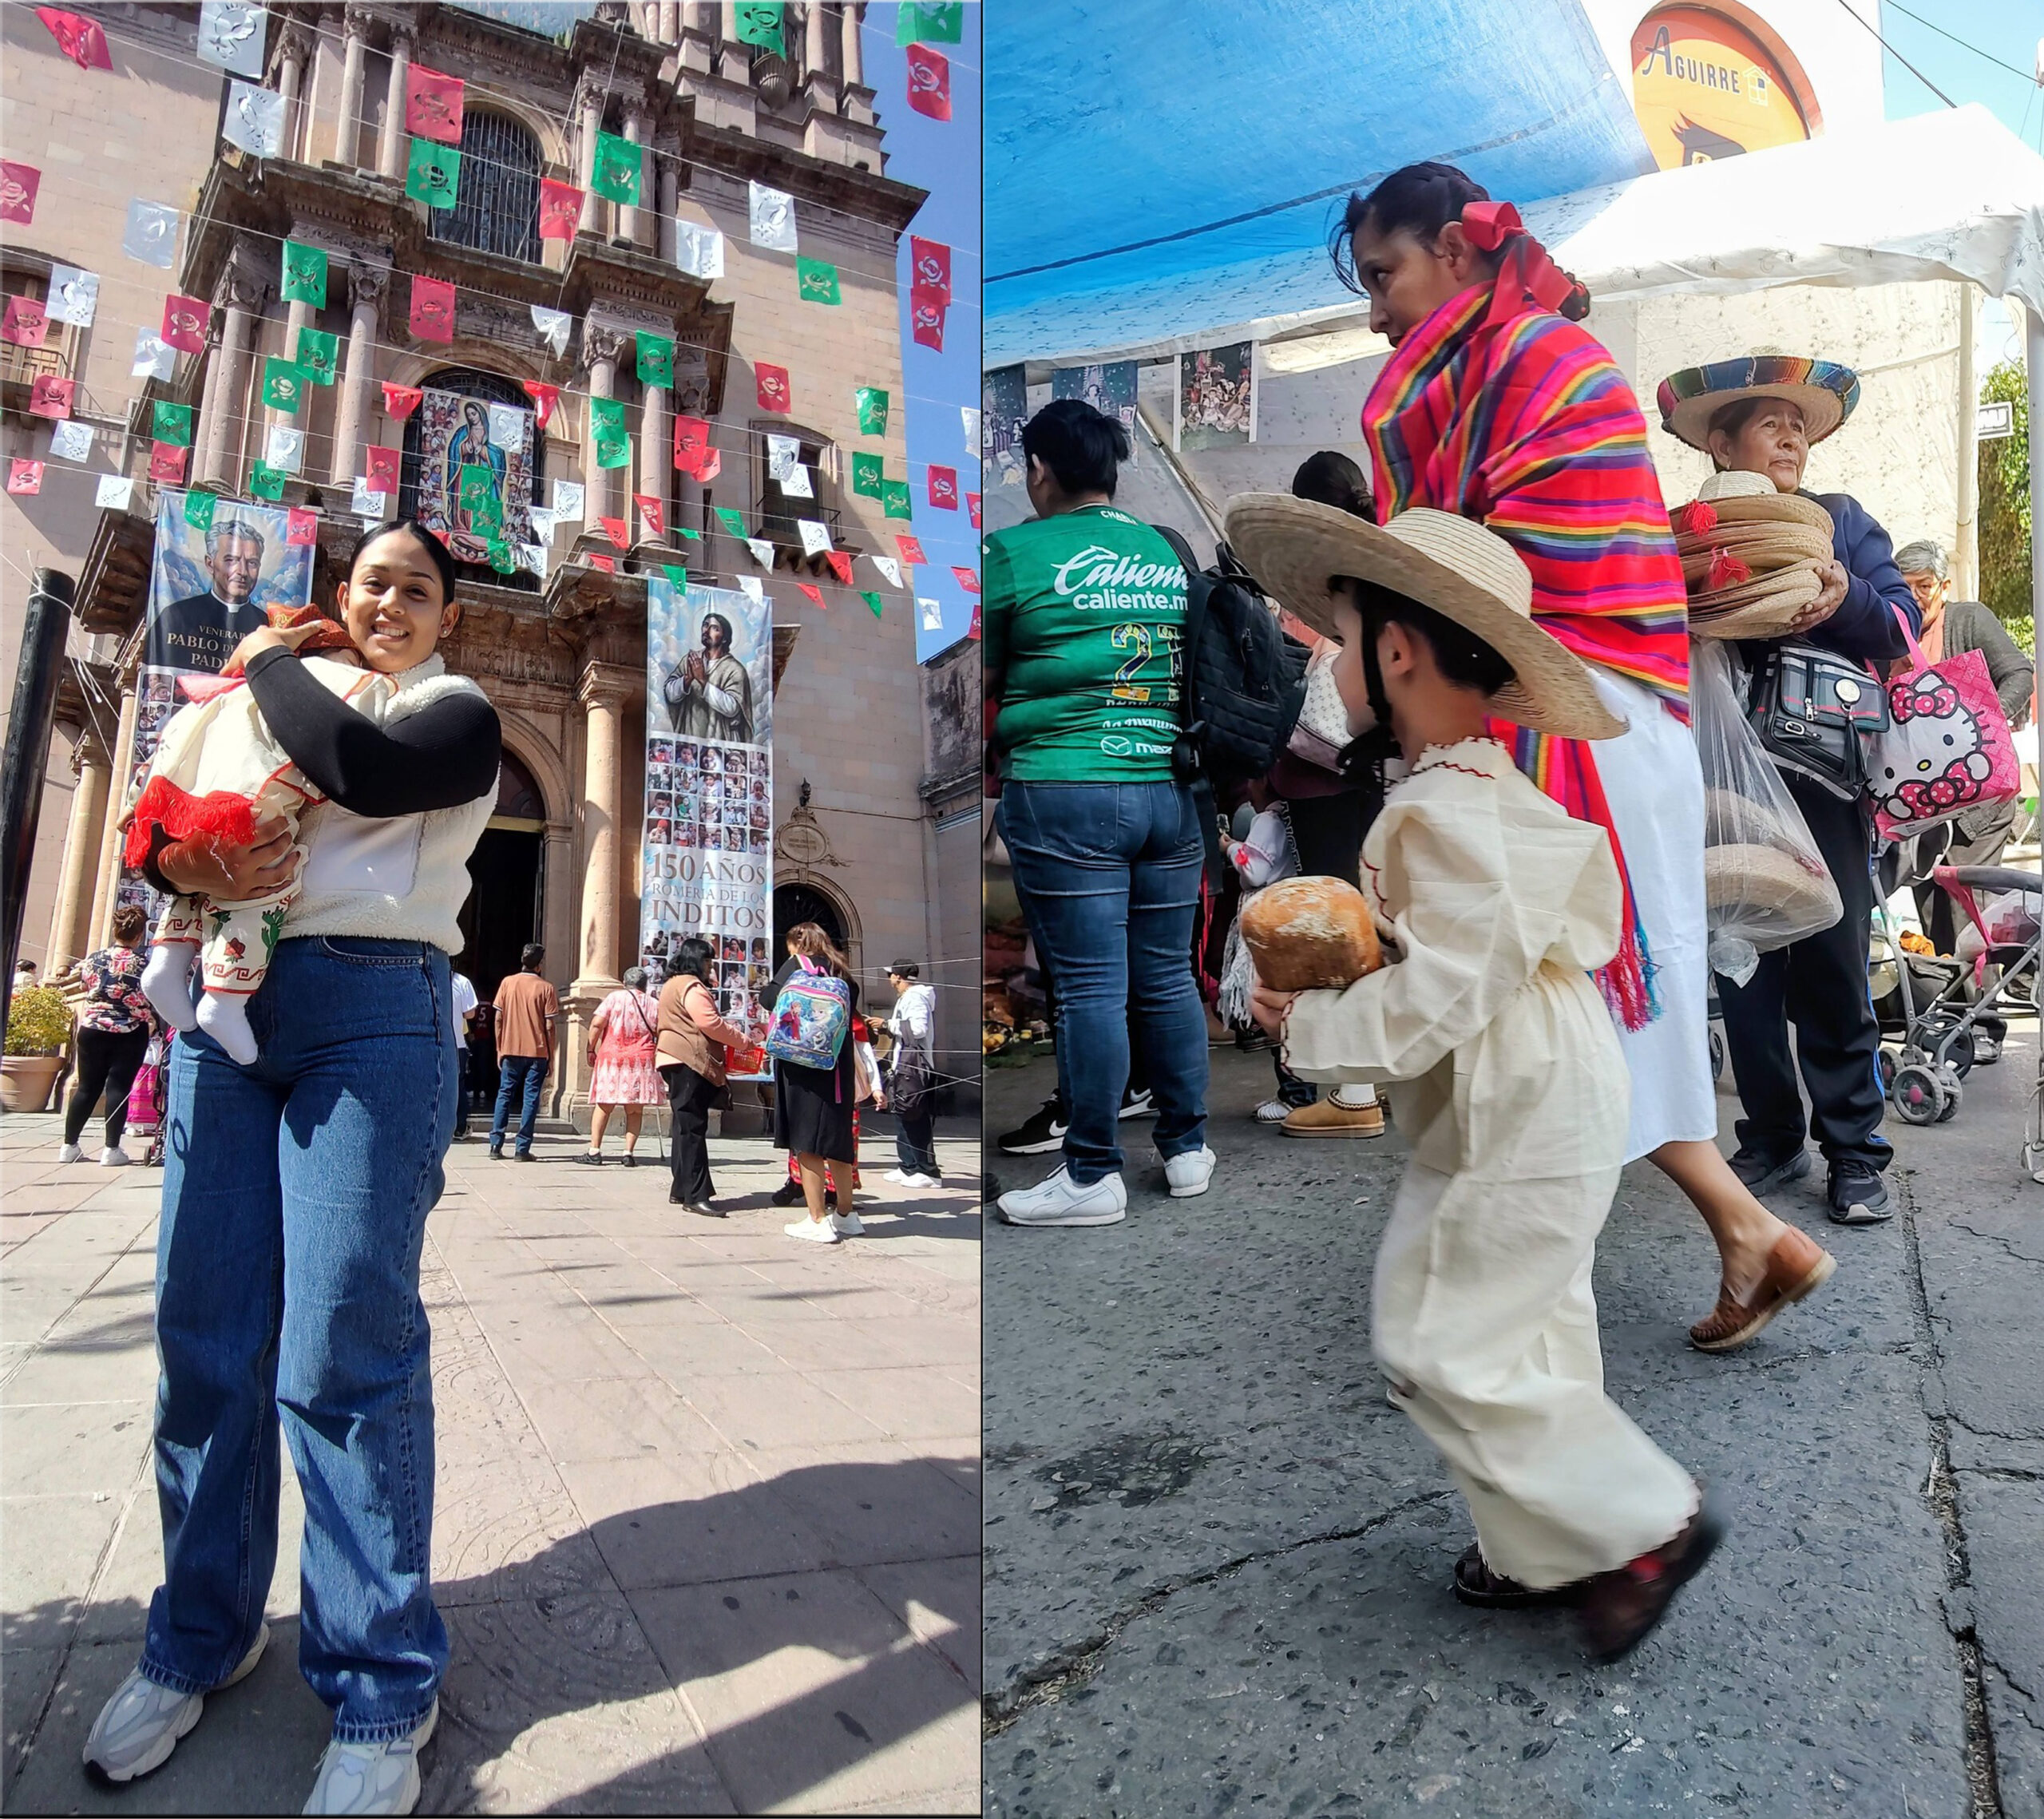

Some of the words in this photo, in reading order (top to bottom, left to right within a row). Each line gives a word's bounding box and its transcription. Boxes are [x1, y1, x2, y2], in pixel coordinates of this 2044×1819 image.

[1642, 25, 1740, 94] AGUIRRE
[167, 632, 219, 652] PABLO
[653, 852, 695, 882] 150
[699, 858, 766, 886] AÑOS
[719, 890, 739, 902] DE
[743, 891, 766, 906] LOS
[652, 899, 766, 929] INDITOS
